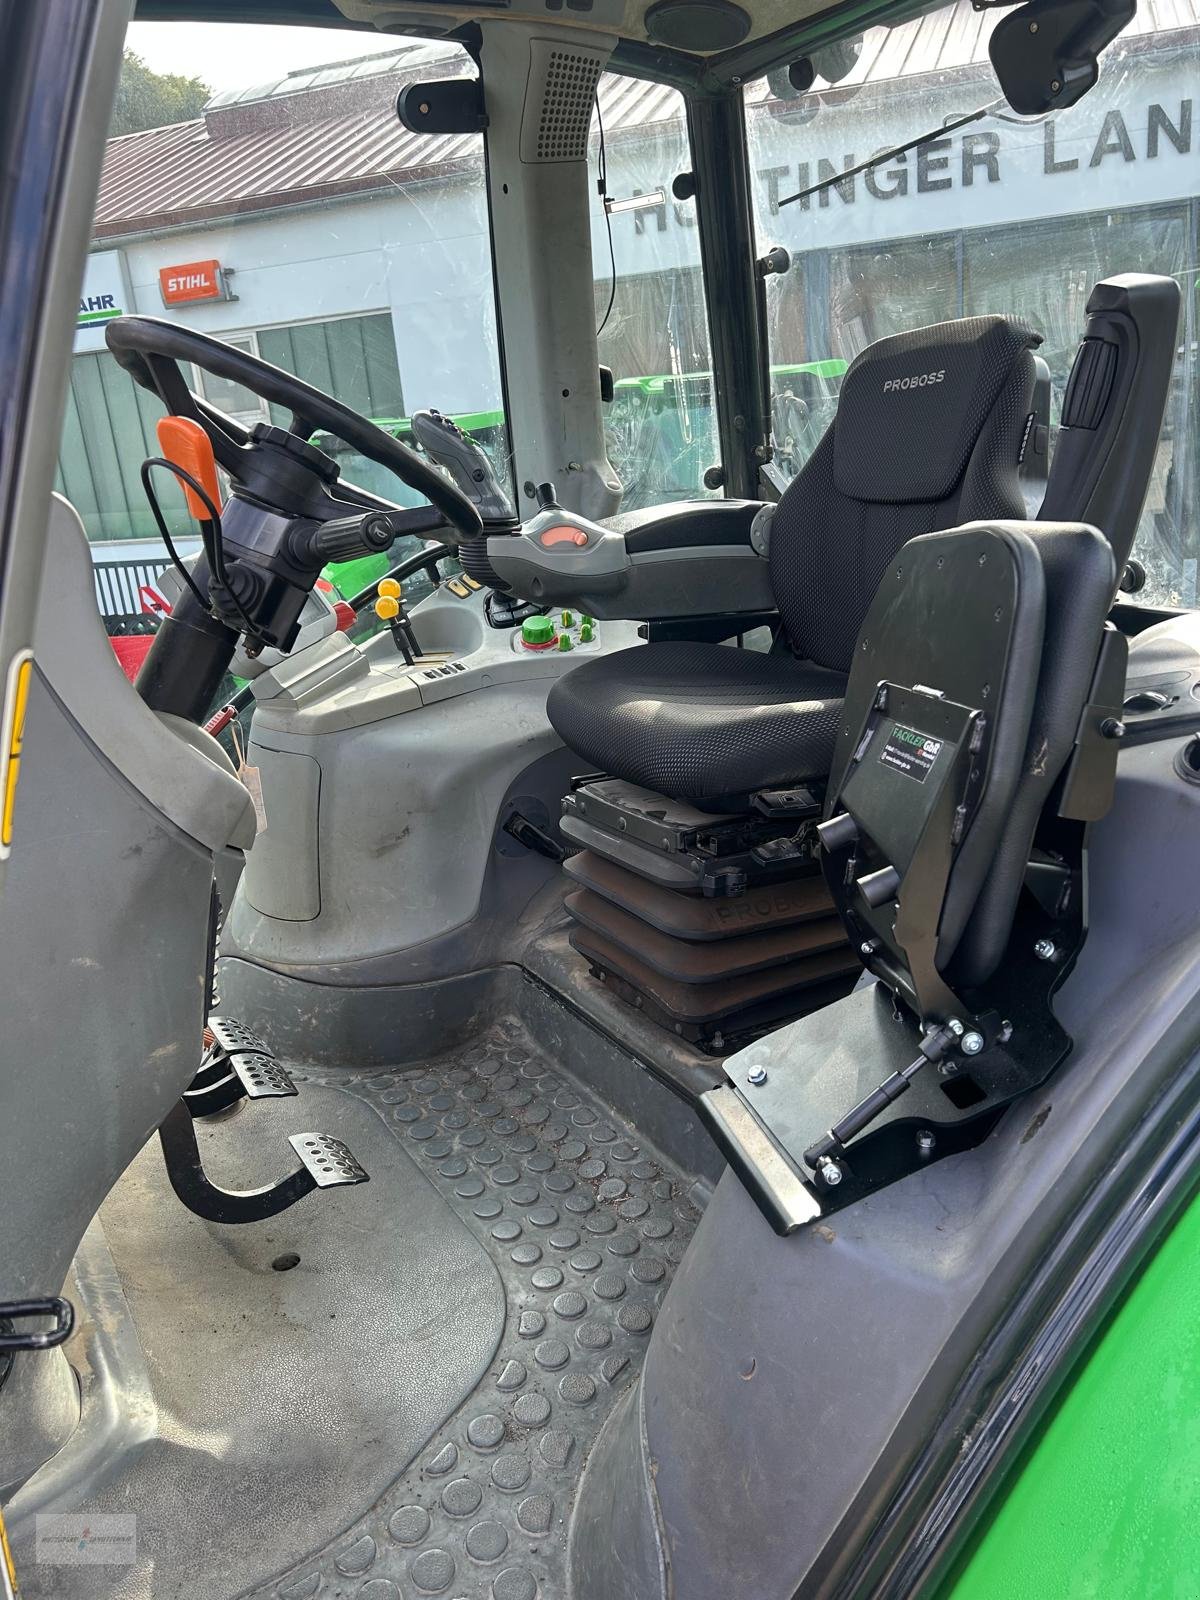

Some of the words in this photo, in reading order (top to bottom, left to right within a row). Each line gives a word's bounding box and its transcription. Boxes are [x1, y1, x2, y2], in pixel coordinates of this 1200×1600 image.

[1044, 99, 1200, 174] LAN
[168, 274, 210, 292] STIHL
[883, 370, 946, 392] PROBOSS
[892, 727, 926, 747] FACKLER
